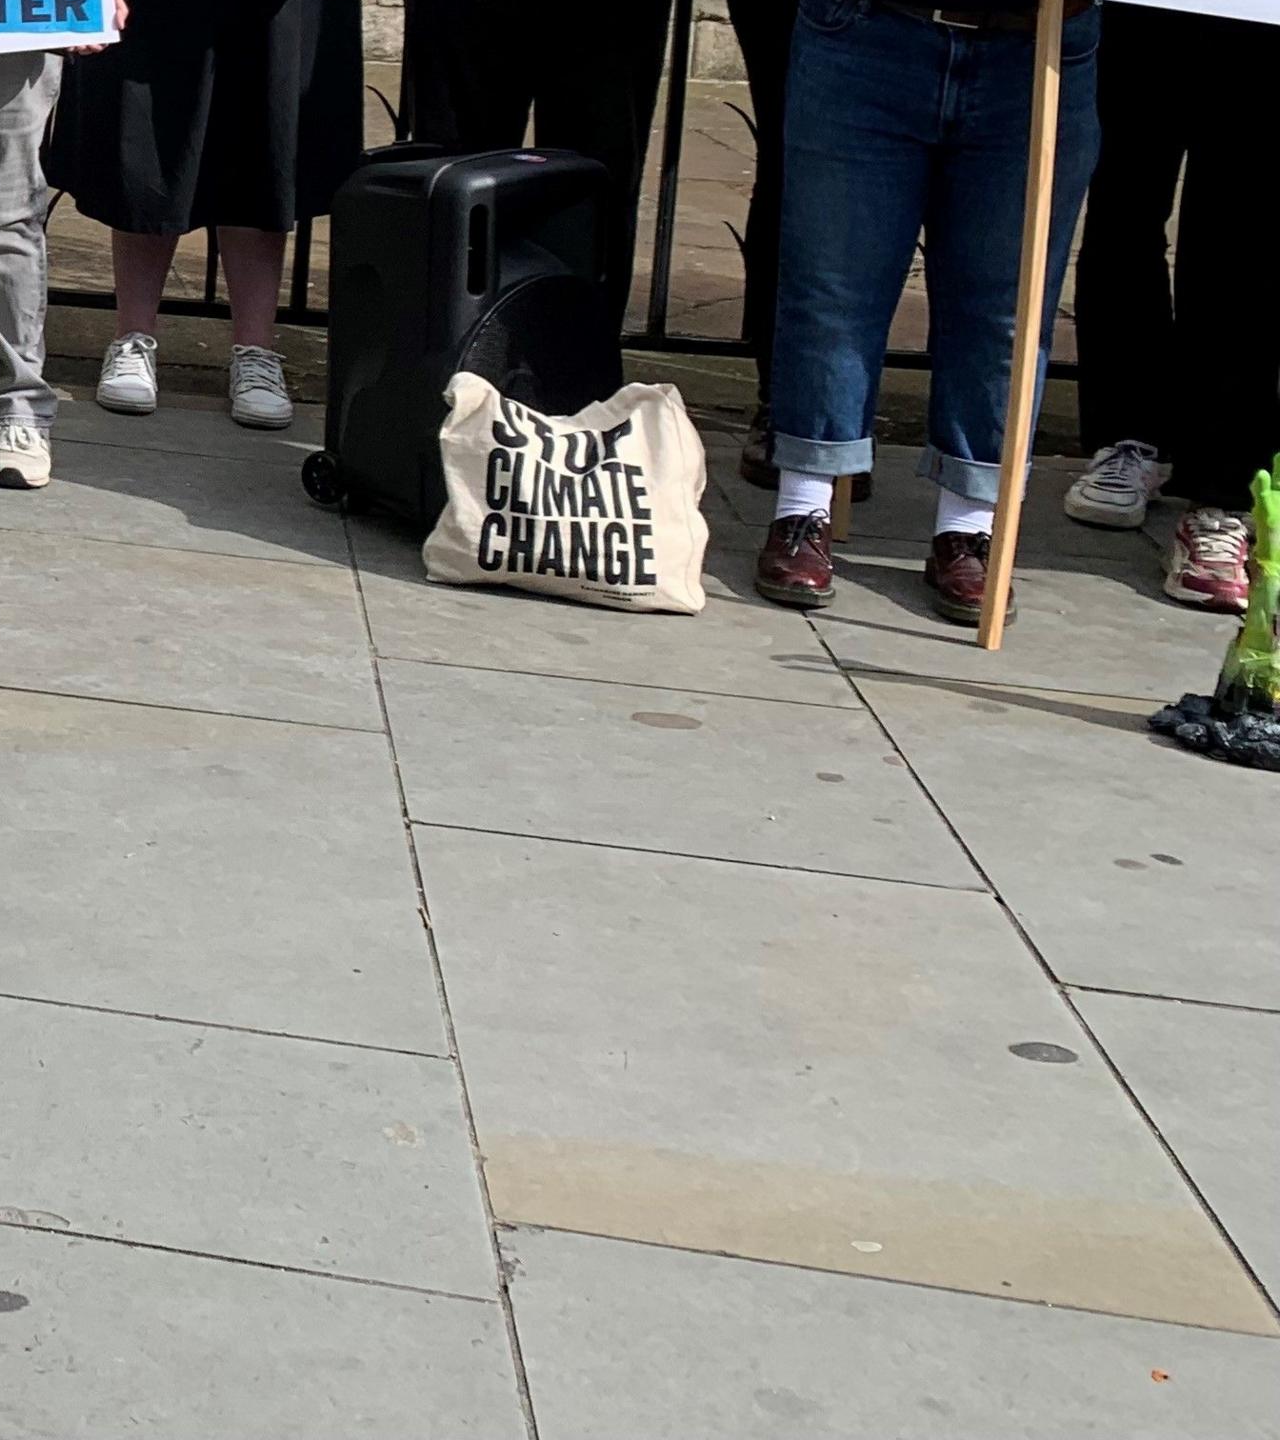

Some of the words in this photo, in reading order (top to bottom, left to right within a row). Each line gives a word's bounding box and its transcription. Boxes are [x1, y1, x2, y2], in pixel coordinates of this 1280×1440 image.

[492, 395, 632, 475] STOP
[486, 447, 652, 520] CLIMATE
[478, 512, 657, 586] CHANGE
